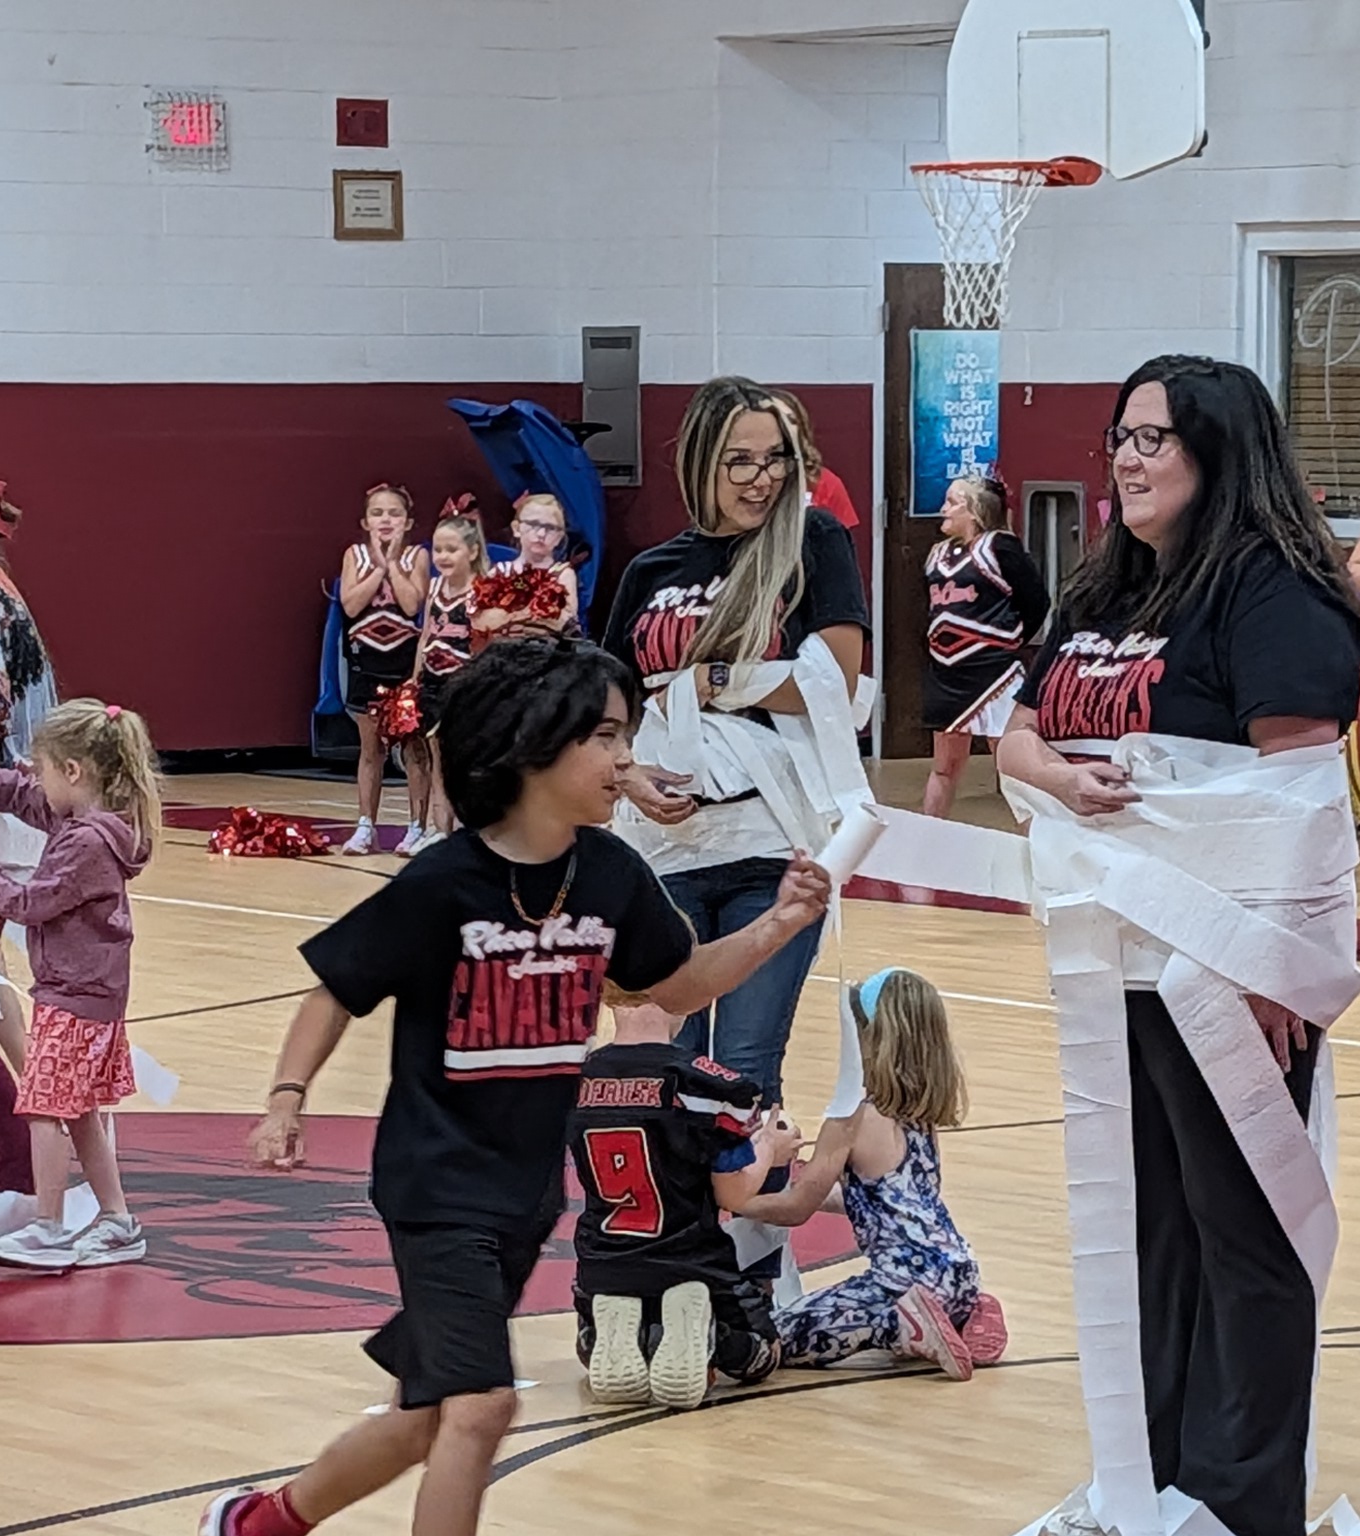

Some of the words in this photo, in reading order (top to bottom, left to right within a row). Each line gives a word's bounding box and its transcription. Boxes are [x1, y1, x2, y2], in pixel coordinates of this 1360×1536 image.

[955, 353, 980, 369] DO
[944, 369, 993, 385] WHAT
[960, 385, 977, 400] IS
[944, 400, 992, 416] RIGHT
[951, 416, 985, 431] NOT
[943, 431, 993, 447] WHAT
[583, 1127, 663, 1237] 9
